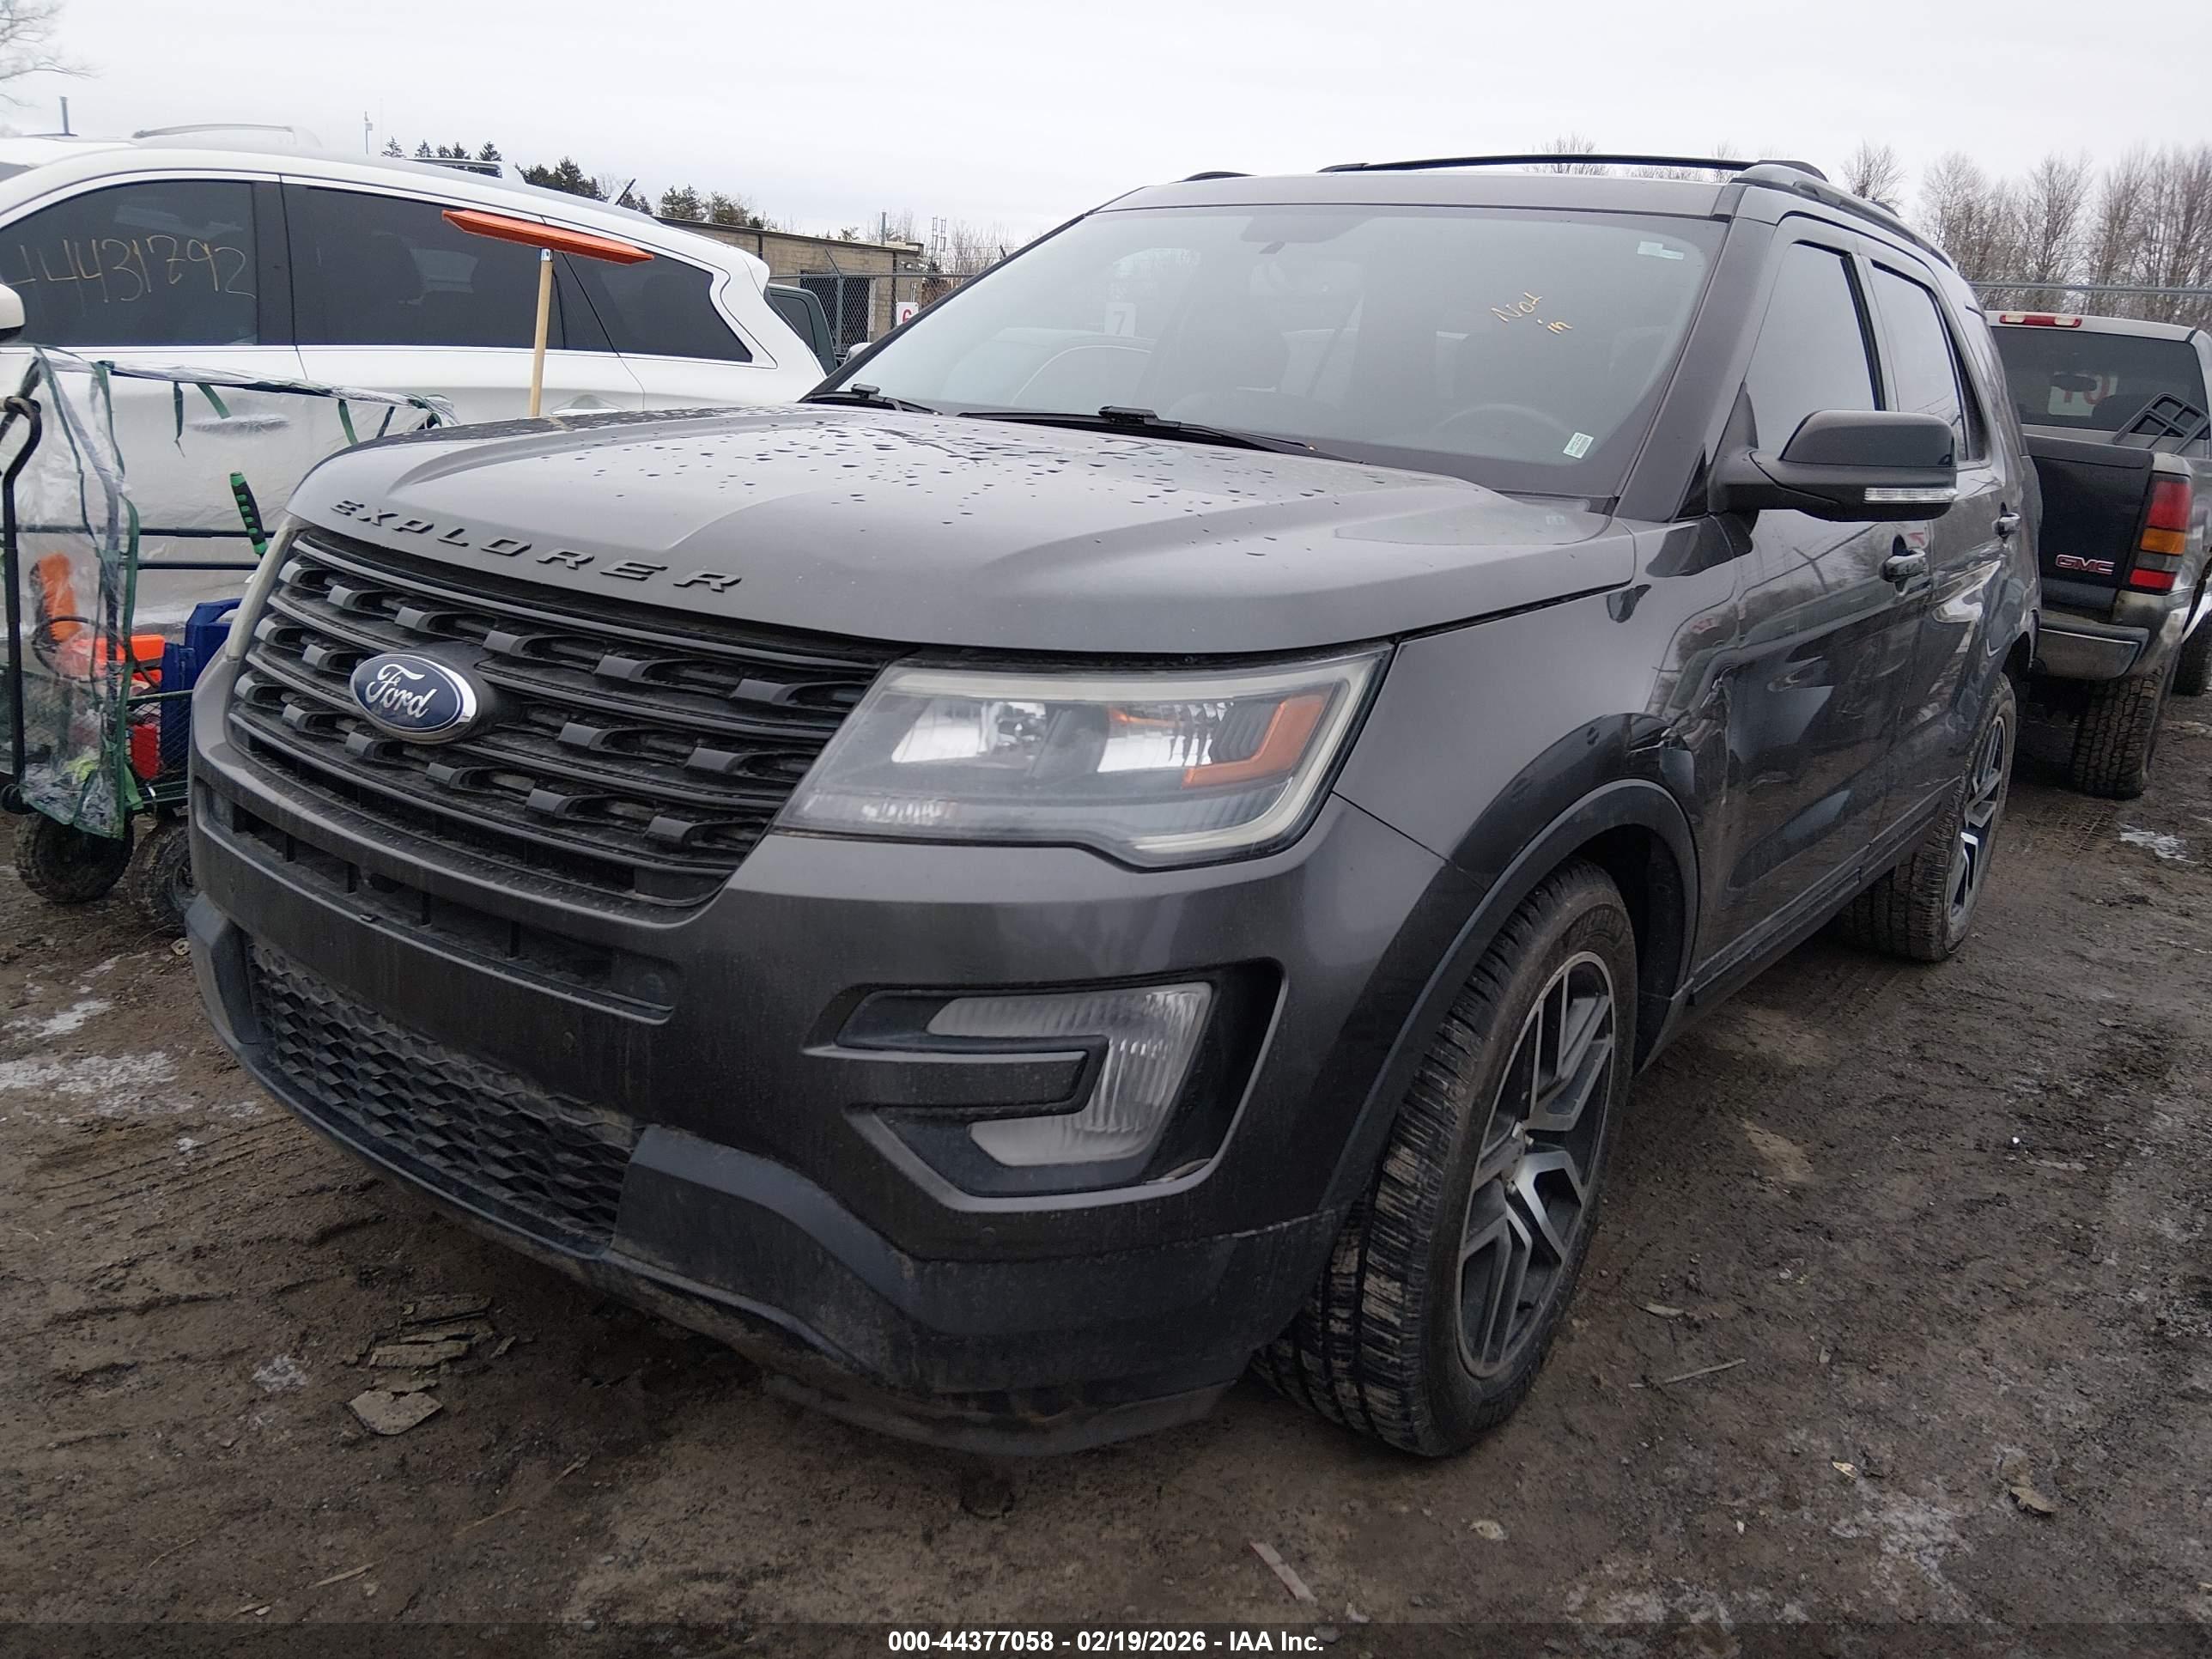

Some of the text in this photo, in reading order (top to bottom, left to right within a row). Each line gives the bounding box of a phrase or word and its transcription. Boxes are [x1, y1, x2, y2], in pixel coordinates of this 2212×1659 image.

[330, 499, 742, 592] EXPLORER
[2055, 554, 2116, 575] GMC
[365, 663, 438, 719] Ford
